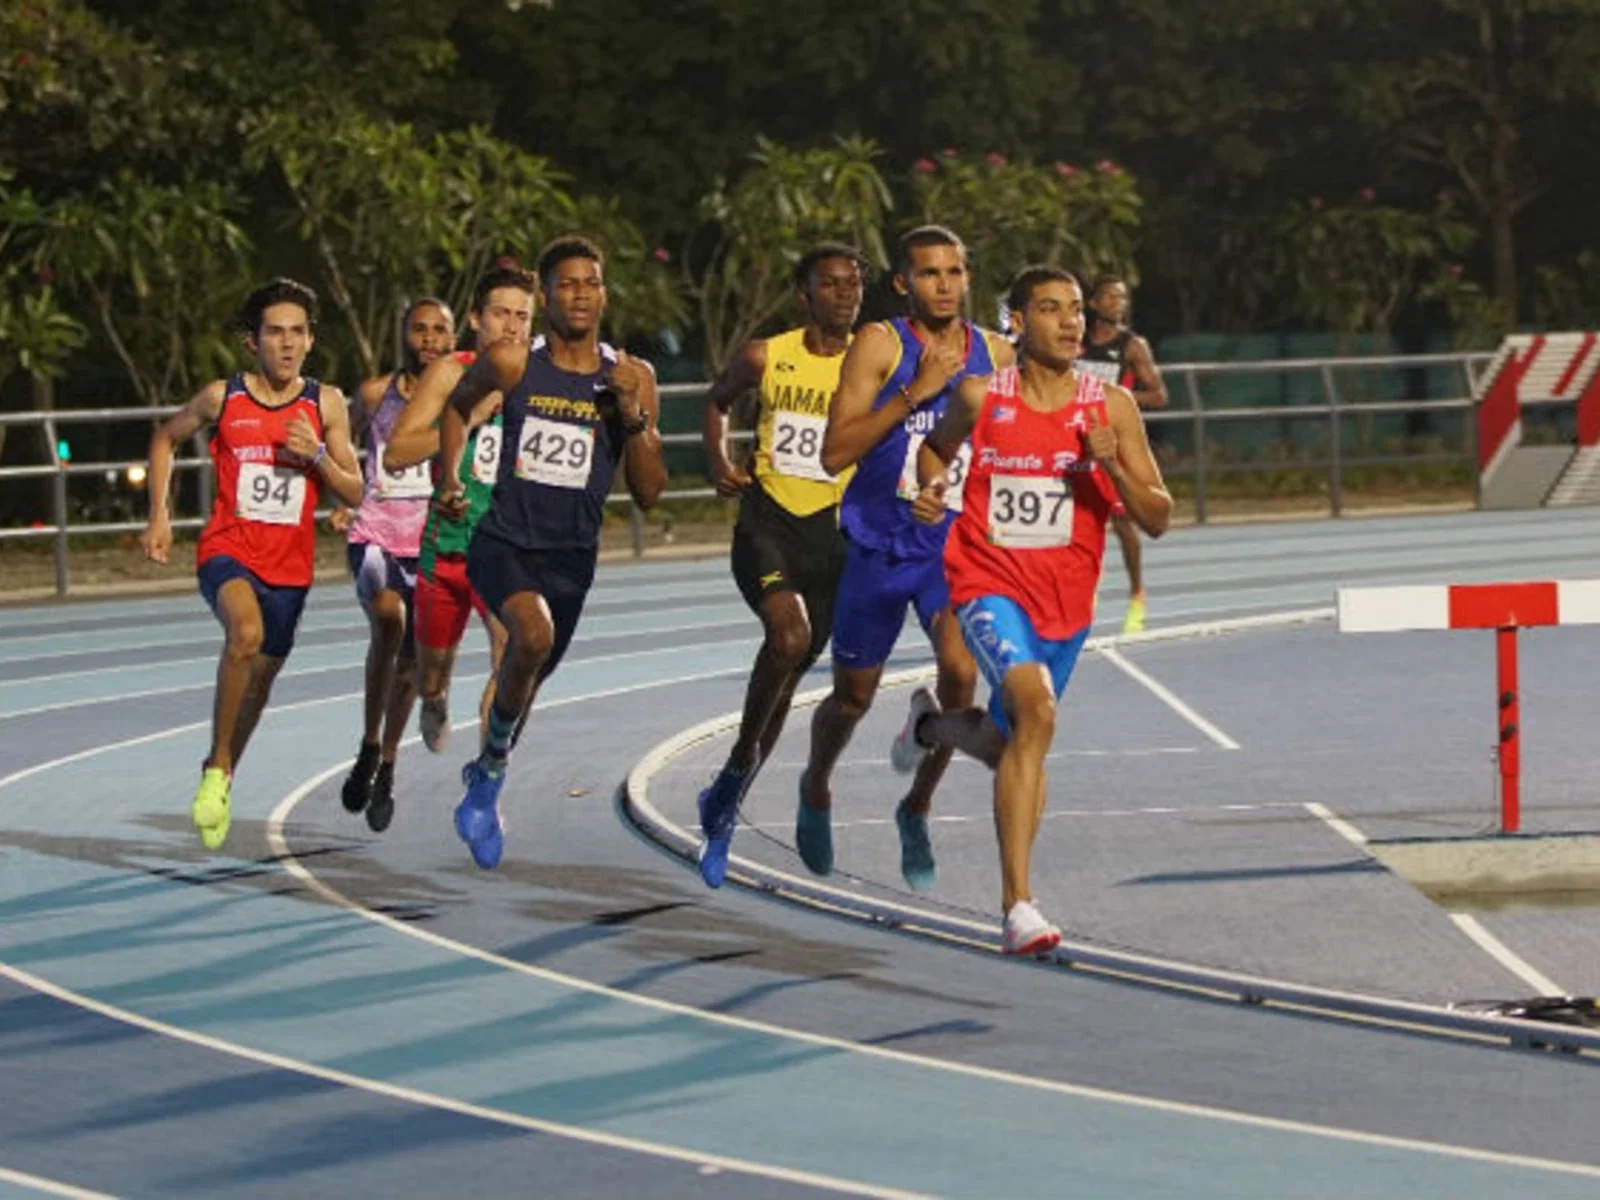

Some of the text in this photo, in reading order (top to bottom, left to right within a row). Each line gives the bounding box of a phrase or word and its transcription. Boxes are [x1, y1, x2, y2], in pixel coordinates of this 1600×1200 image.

[479, 436, 496, 464] 3
[523, 431, 588, 469] 429
[776, 424, 818, 458] 28
[979, 447, 1043, 470] Puerto
[251, 474, 291, 506] 94
[993, 487, 1071, 526] 397
